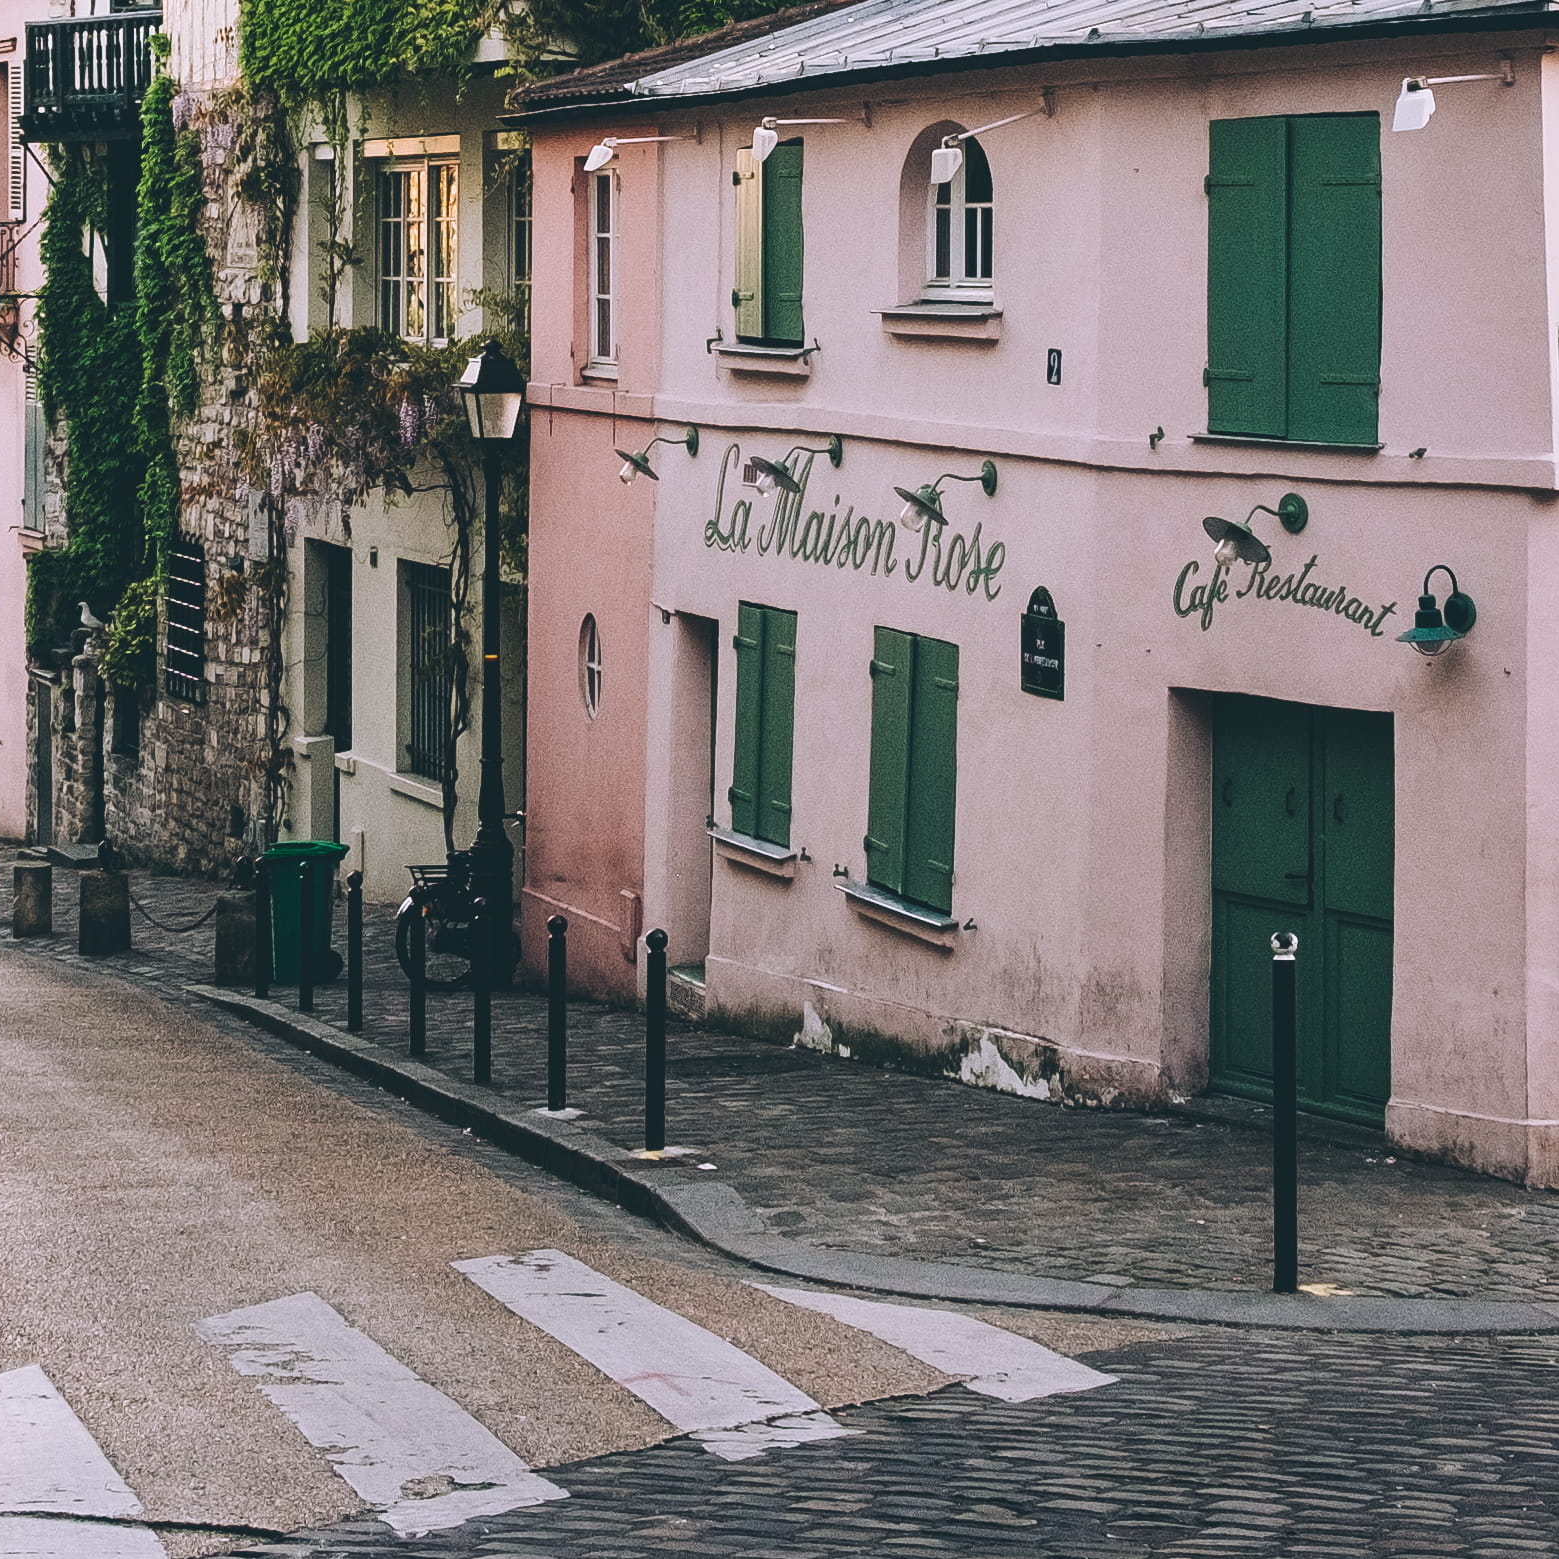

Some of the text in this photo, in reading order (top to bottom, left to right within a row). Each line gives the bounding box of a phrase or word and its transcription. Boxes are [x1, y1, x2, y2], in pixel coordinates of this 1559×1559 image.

[1050, 351, 1059, 383] 2
[704, 442, 1006, 602] La Maison Rose
[1173, 550, 1398, 637] Café Restaurant
